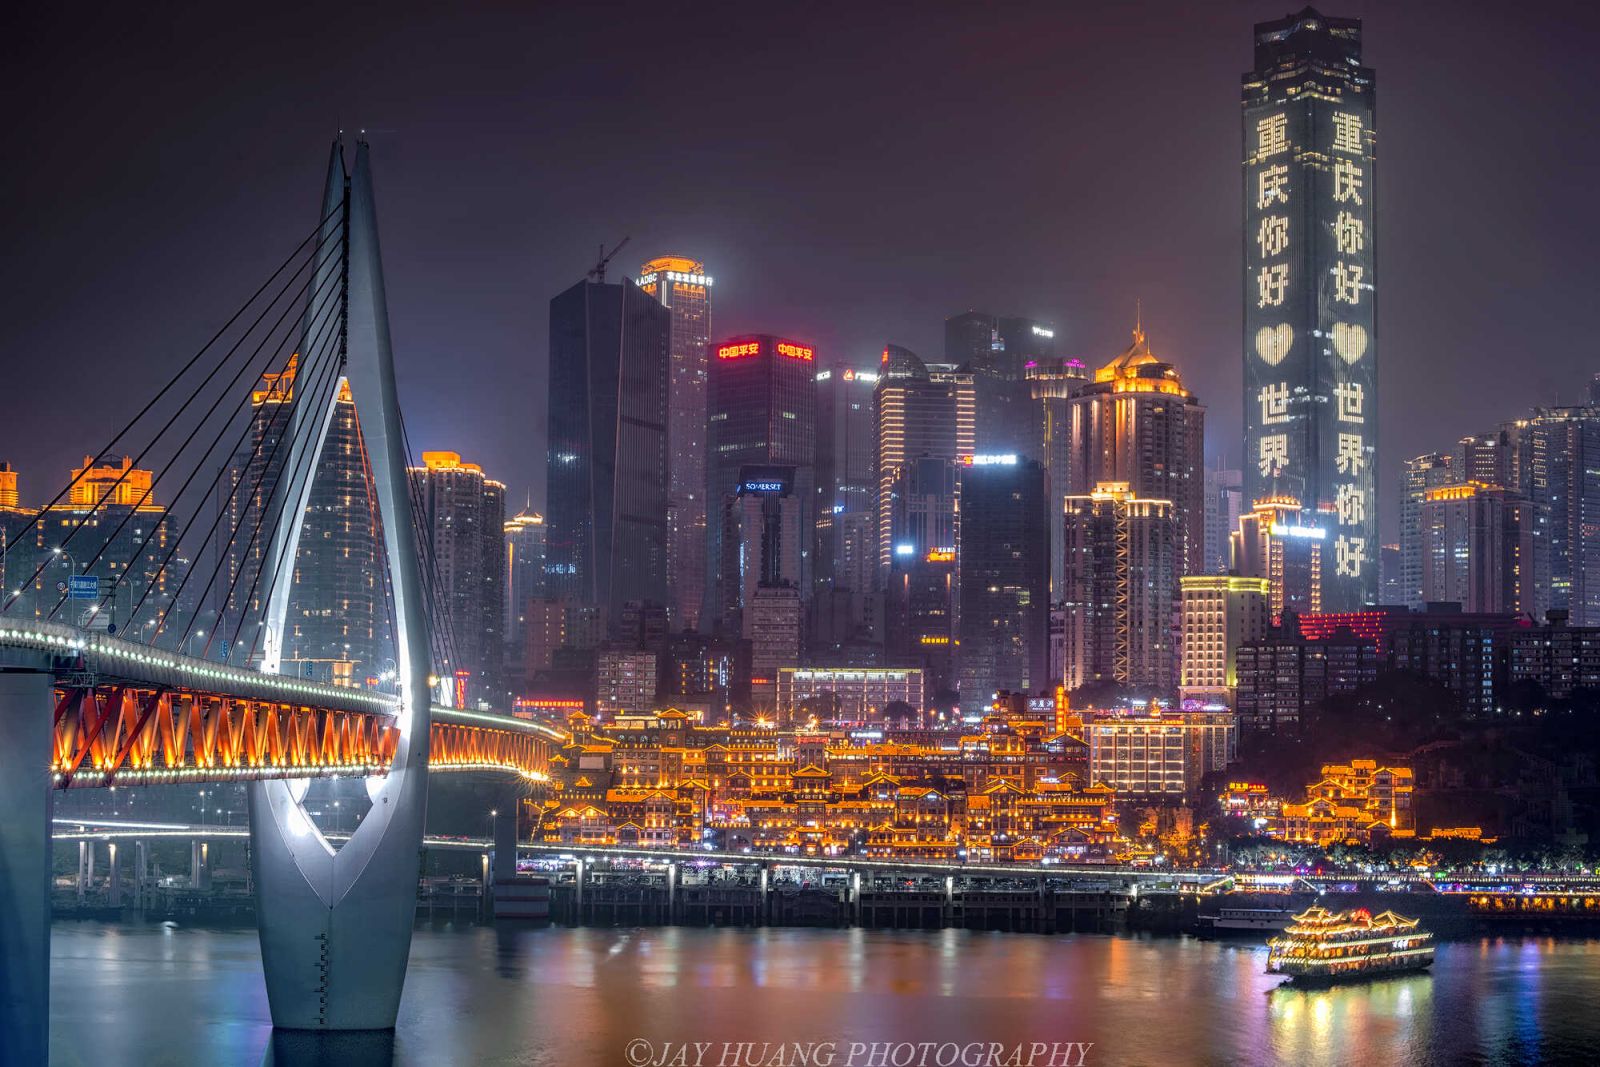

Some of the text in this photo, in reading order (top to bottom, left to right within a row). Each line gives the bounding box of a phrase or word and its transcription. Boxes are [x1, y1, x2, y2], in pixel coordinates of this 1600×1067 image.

[1257, 112, 1290, 309] 重庆你好
[719, 343, 759, 359] 中国平安
[778, 343, 813, 361] 中国平安
[1332, 111, 1365, 578] 重庆你好 世界你好
[745, 483, 782, 491] SOMERSET
